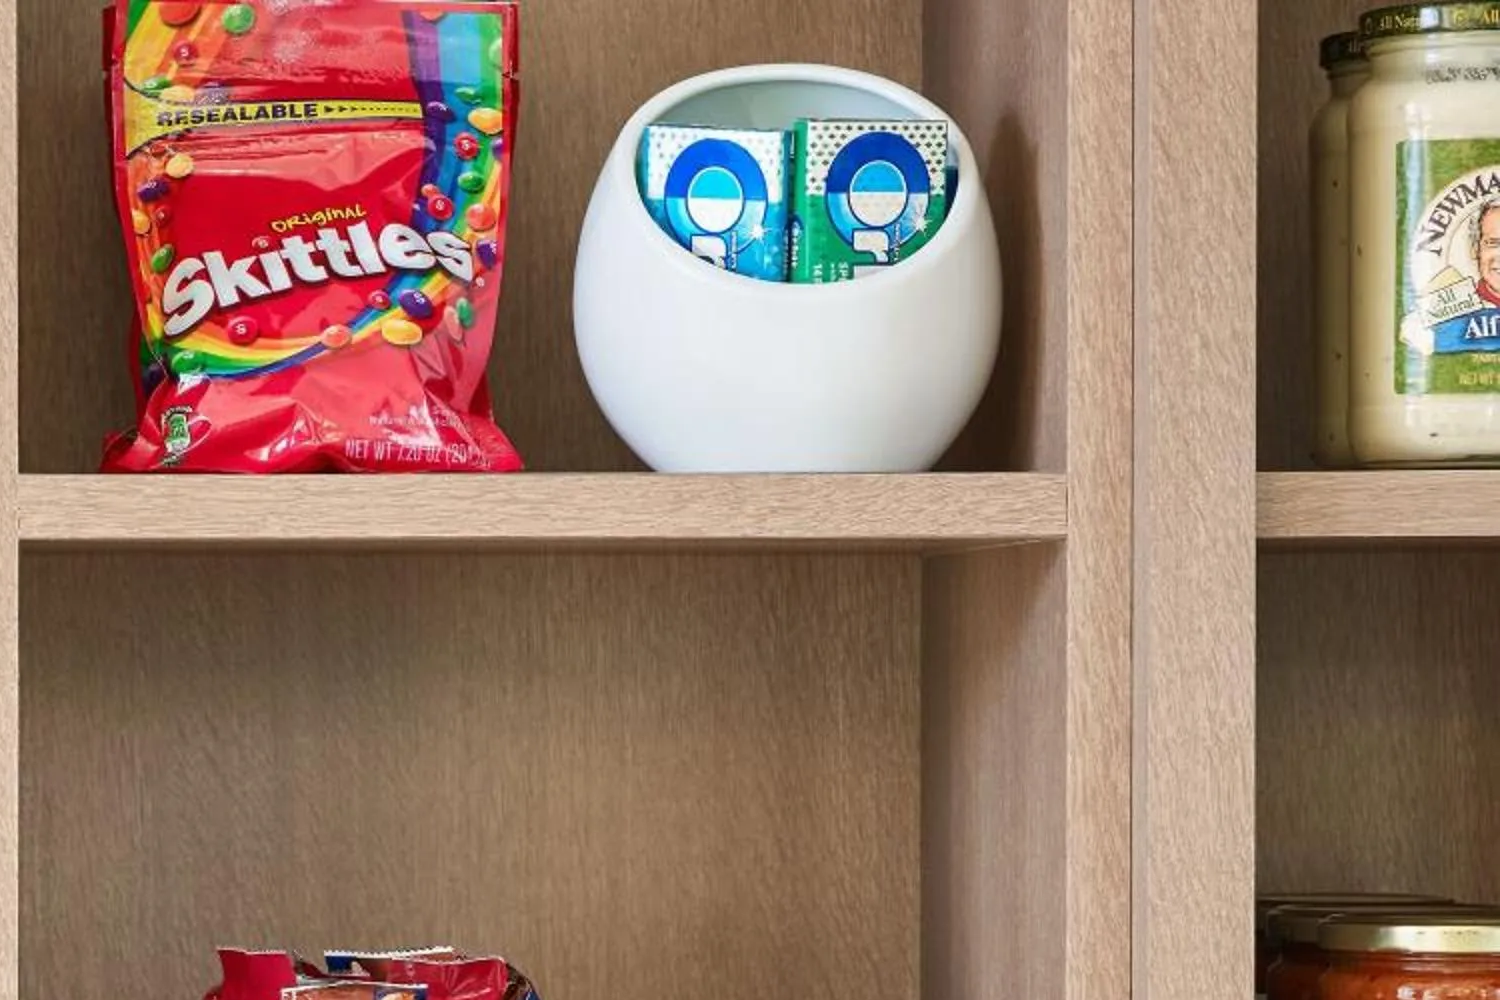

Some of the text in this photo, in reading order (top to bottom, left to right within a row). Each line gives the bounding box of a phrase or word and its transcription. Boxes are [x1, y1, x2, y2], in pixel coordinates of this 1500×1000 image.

[156, 103, 318, 127] RESEALABLE
[1417, 172, 1500, 256] NEWMA
[162, 223, 473, 336] Skittles
[1465, 317, 1500, 339] Alf
[345, 439, 369, 459] NET
[373, 440, 392, 460] WT
